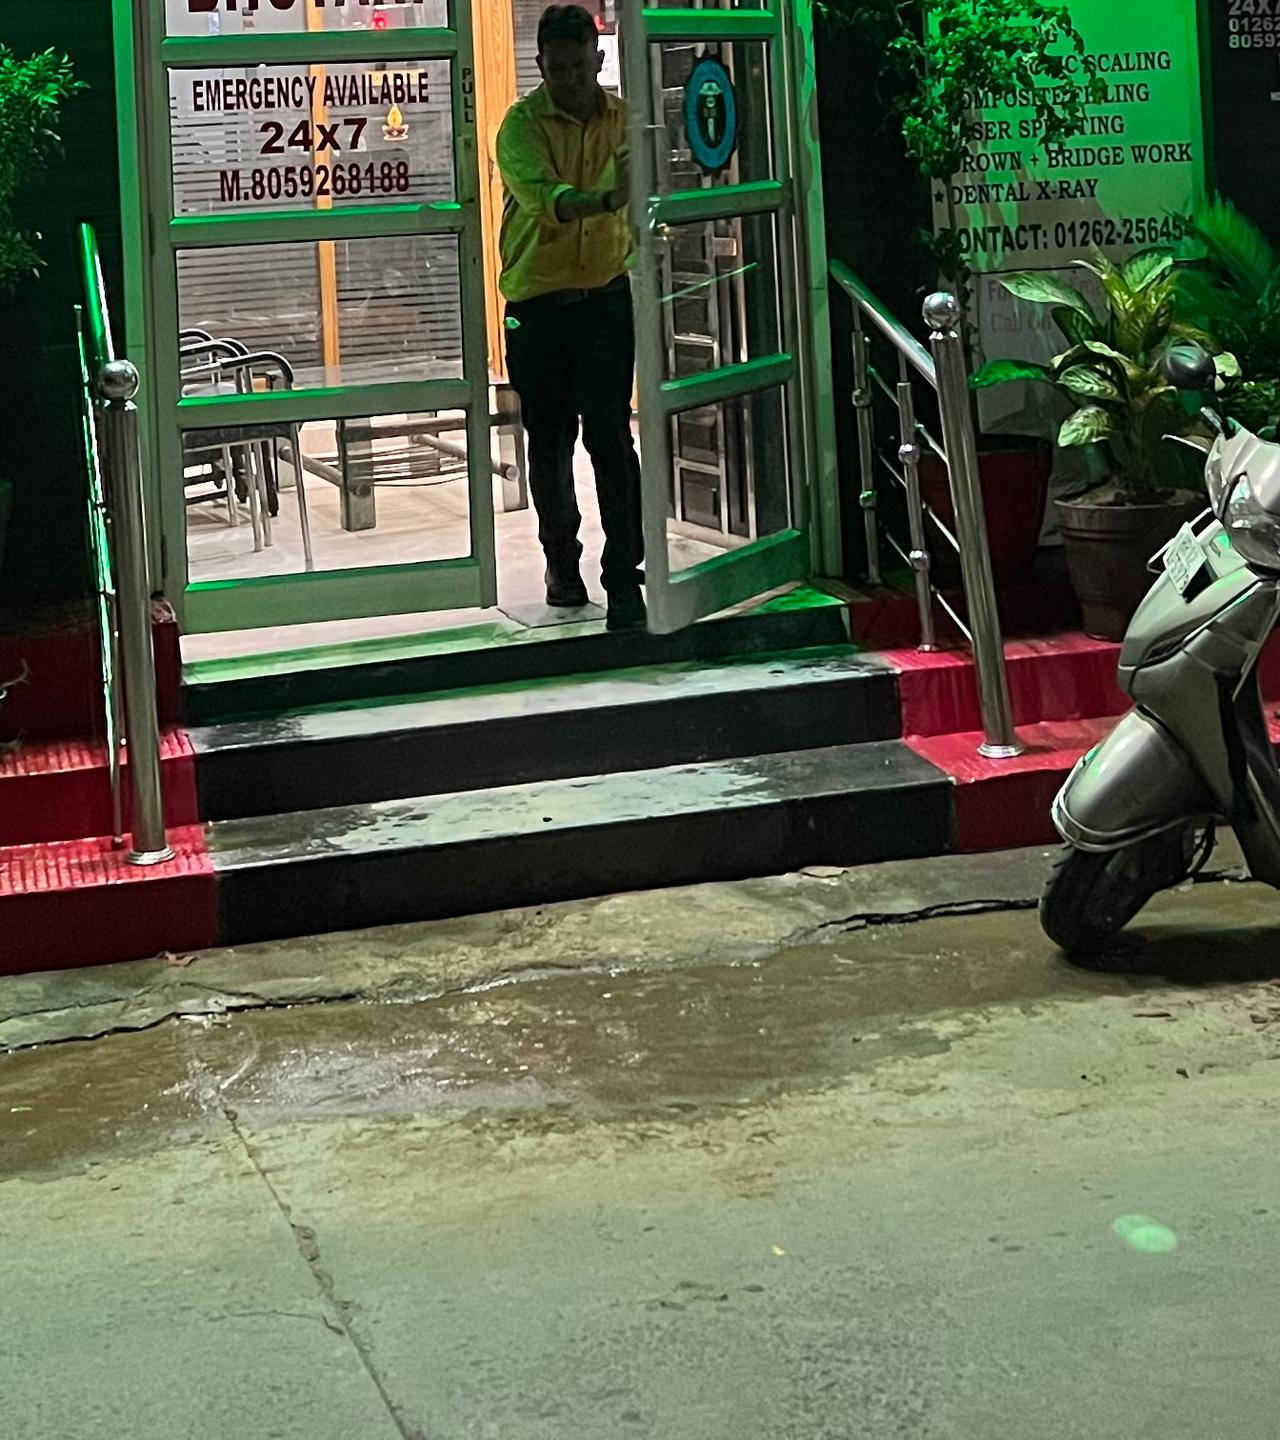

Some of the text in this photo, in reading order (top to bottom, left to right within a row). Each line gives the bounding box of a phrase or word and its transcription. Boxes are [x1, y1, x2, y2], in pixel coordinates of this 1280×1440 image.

[192, 71, 430, 112] EMERGENCY AVAILABLE
[258, 117, 369, 156] 24x7
[1047, 145, 1125, 170] BRIDGE
[1130, 142, 1193, 165] WORK
[219, 160, 411, 203] M.8059268188
[952, 177, 1100, 206] DENTAL X-RAY
[958, 222, 1048, 255] ONTACT:
